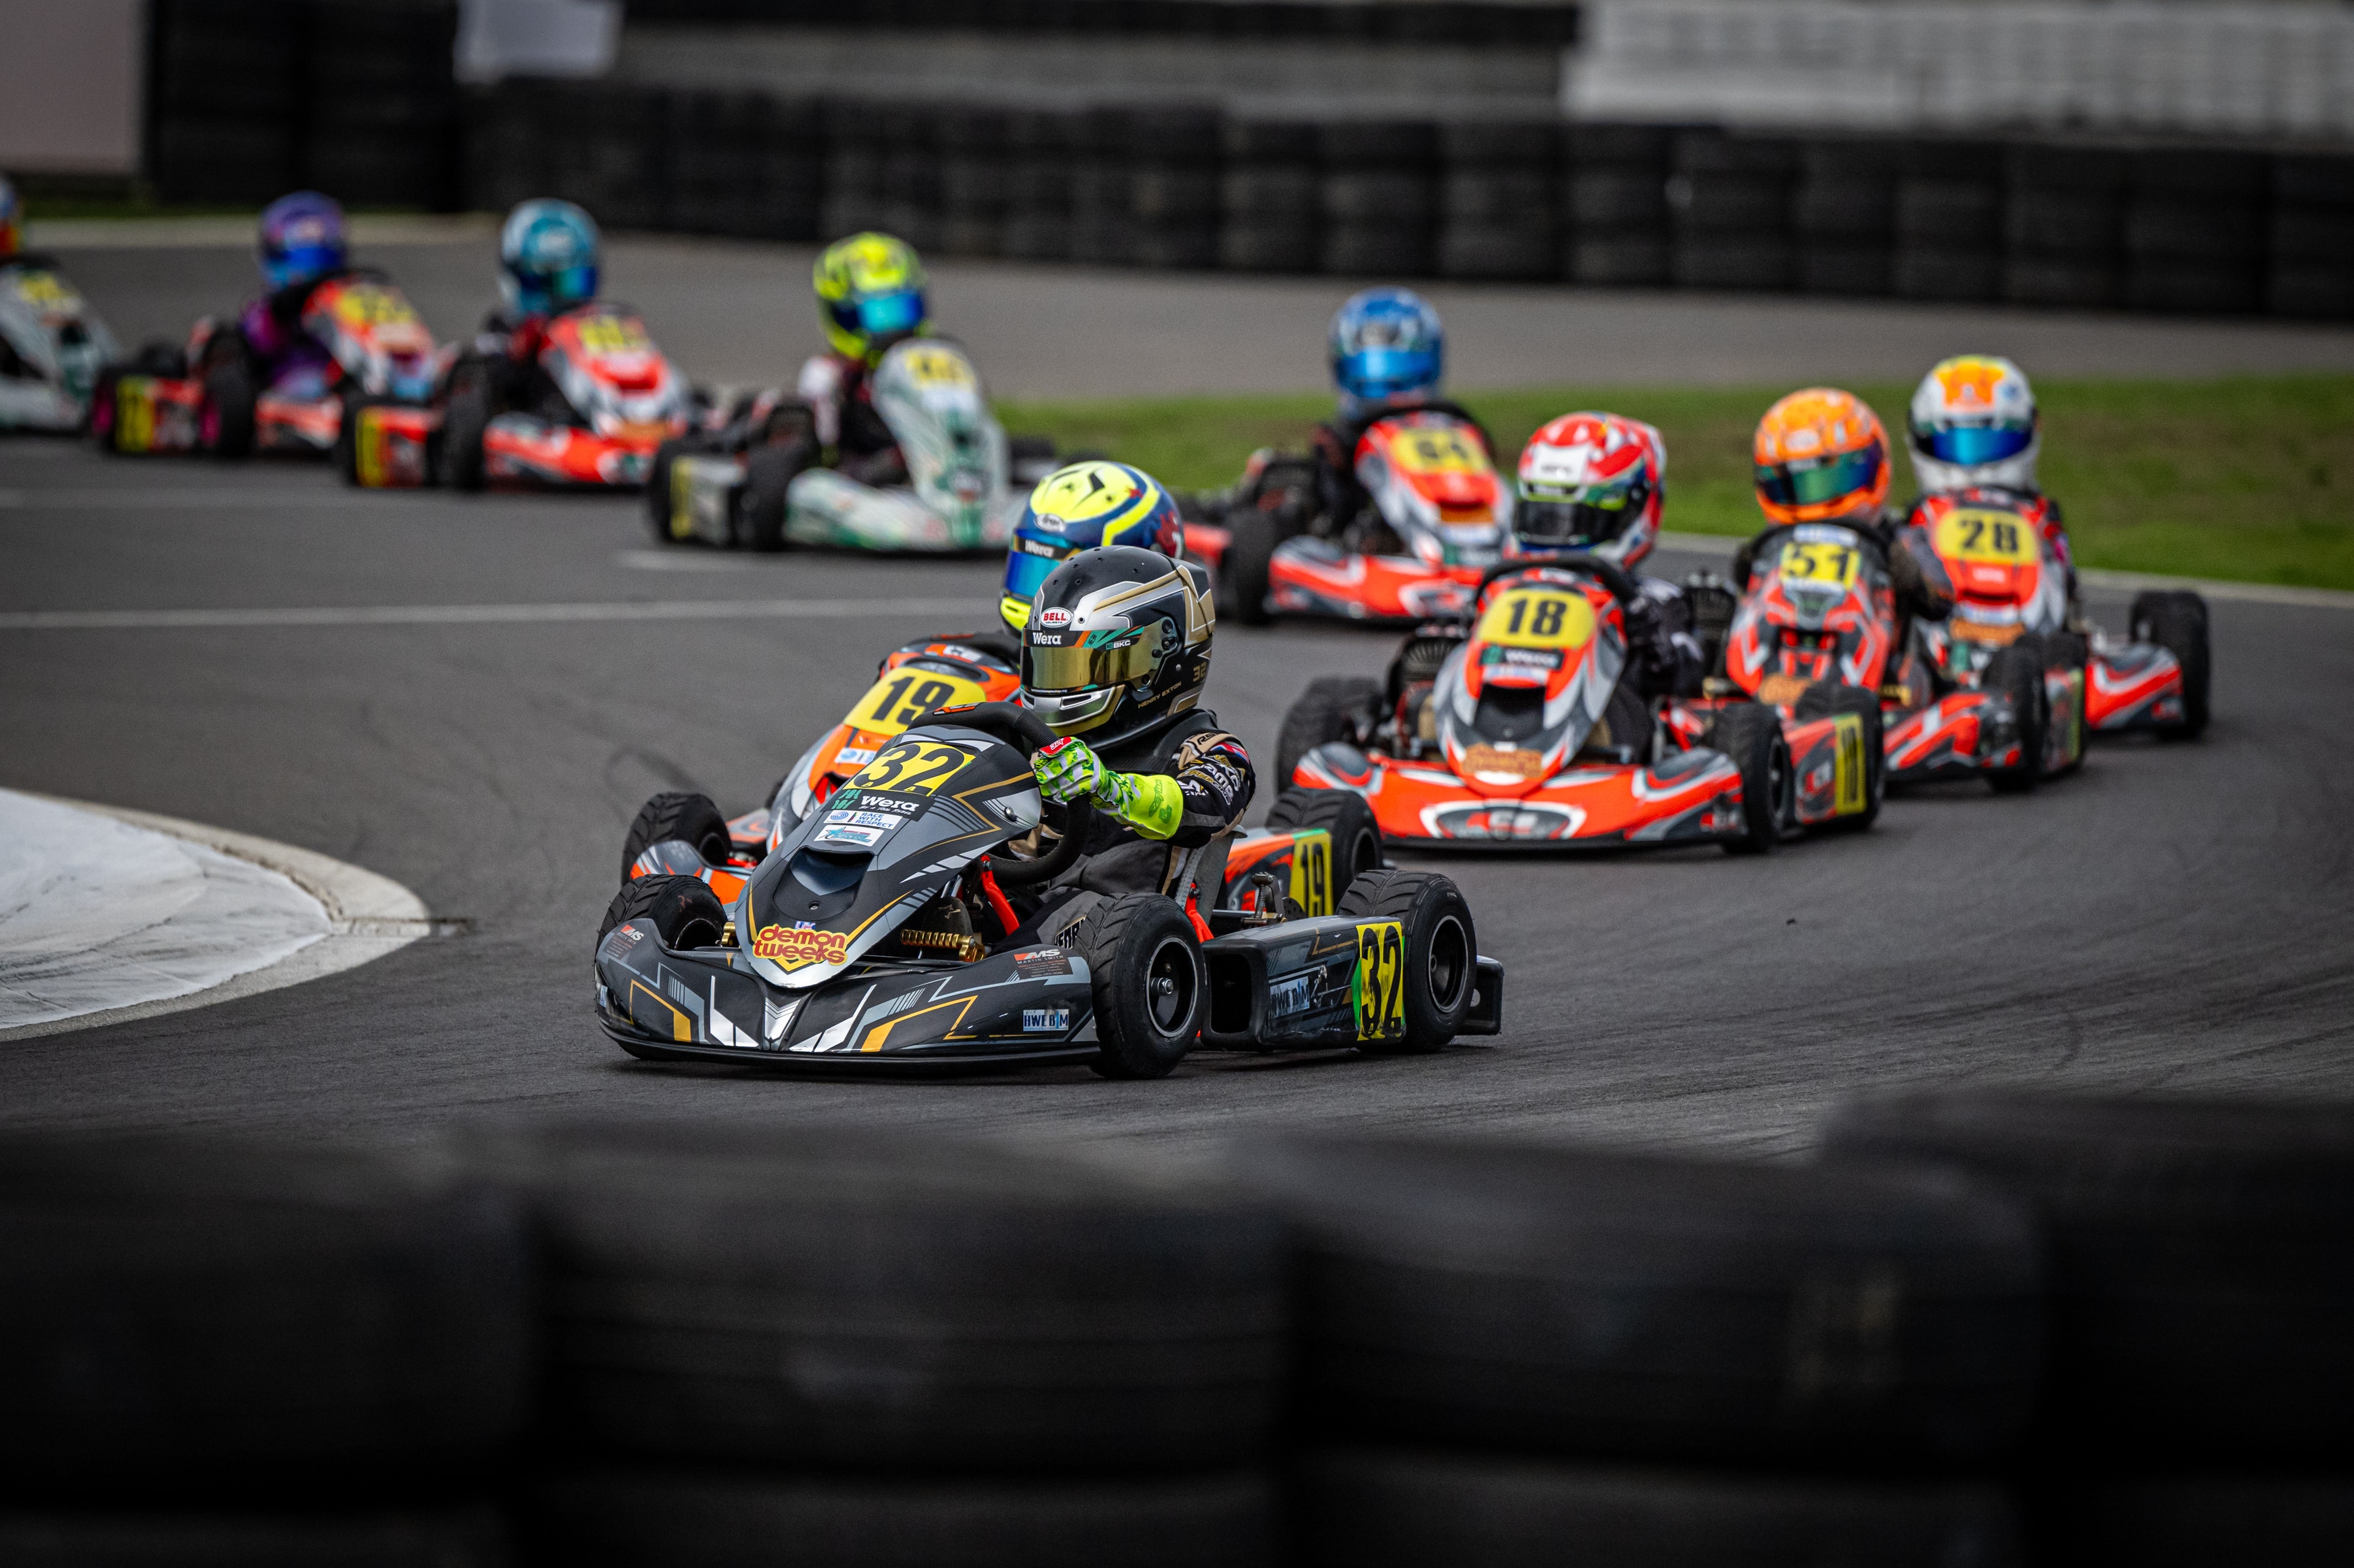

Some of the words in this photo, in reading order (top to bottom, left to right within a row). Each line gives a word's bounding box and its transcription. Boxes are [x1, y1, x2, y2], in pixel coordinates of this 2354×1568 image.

[1025, 539, 1054, 558] Wera
[1958, 520, 2019, 554] 28
[1788, 546, 1849, 582] 51
[1043, 612, 1067, 621] BELL
[1507, 598, 1567, 636] 18
[1032, 632, 1061, 645] Wera
[1113, 640, 1131, 649] BKC
[1193, 661, 1207, 682] 32
[870, 676, 955, 726] 19
[1138, 693, 1160, 709] HENRY
[1162, 681, 1181, 697] EXTON
[853, 744, 965, 796] 32
[861, 796, 920, 812] Wera
[1301, 843, 1325, 917] 19
[626, 928, 644, 941] MS
[760, 926, 845, 949] demon
[754, 940, 845, 964] tweeks
[1024, 949, 1061, 961] MS
[1361, 924, 1402, 1037] 32
